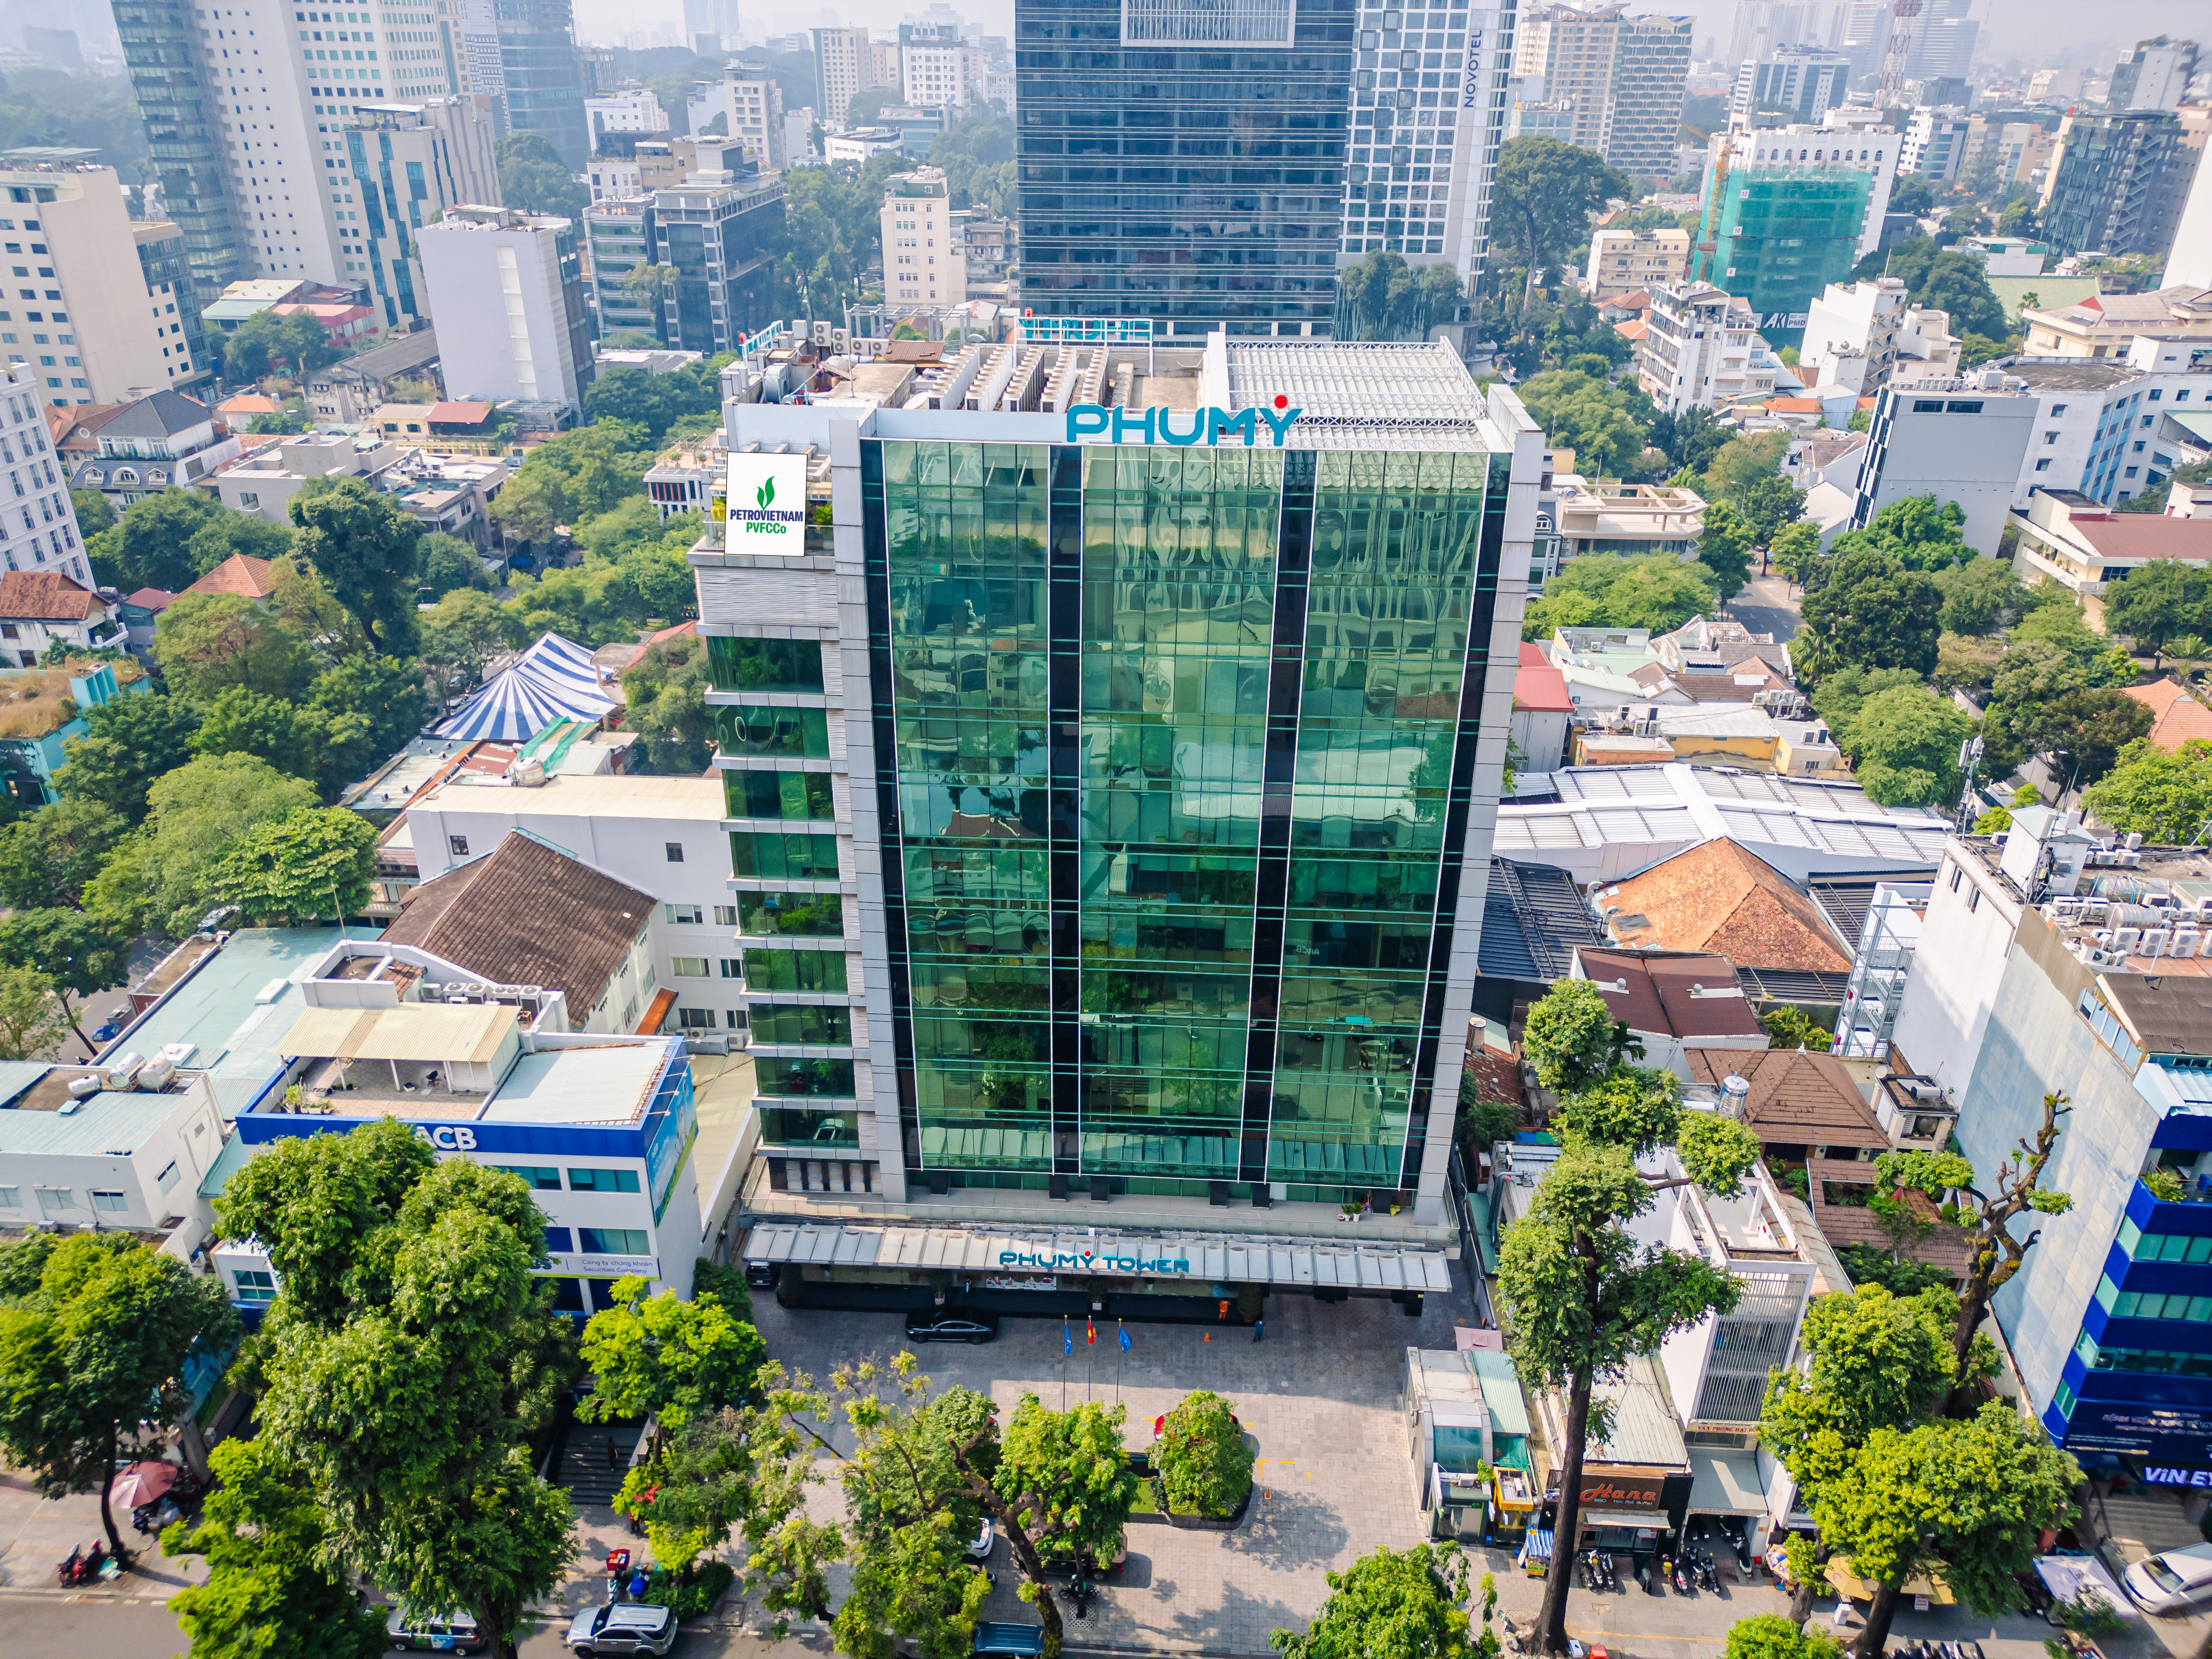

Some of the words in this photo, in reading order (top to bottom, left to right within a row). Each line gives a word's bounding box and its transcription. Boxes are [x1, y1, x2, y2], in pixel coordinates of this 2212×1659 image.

[1464, 30, 1482, 108] NOVOTEL
[1066, 403, 1303, 446] PHUMY
[730, 509, 803, 522] PETROVIETNAM
[746, 522, 787, 534] PVFCCo
[415, 1126, 477, 1149] ACB
[999, 1251, 1097, 1269] PHUMY
[1102, 1255, 1189, 1273] TOWER
[1580, 1483, 1656, 1502] Hana
